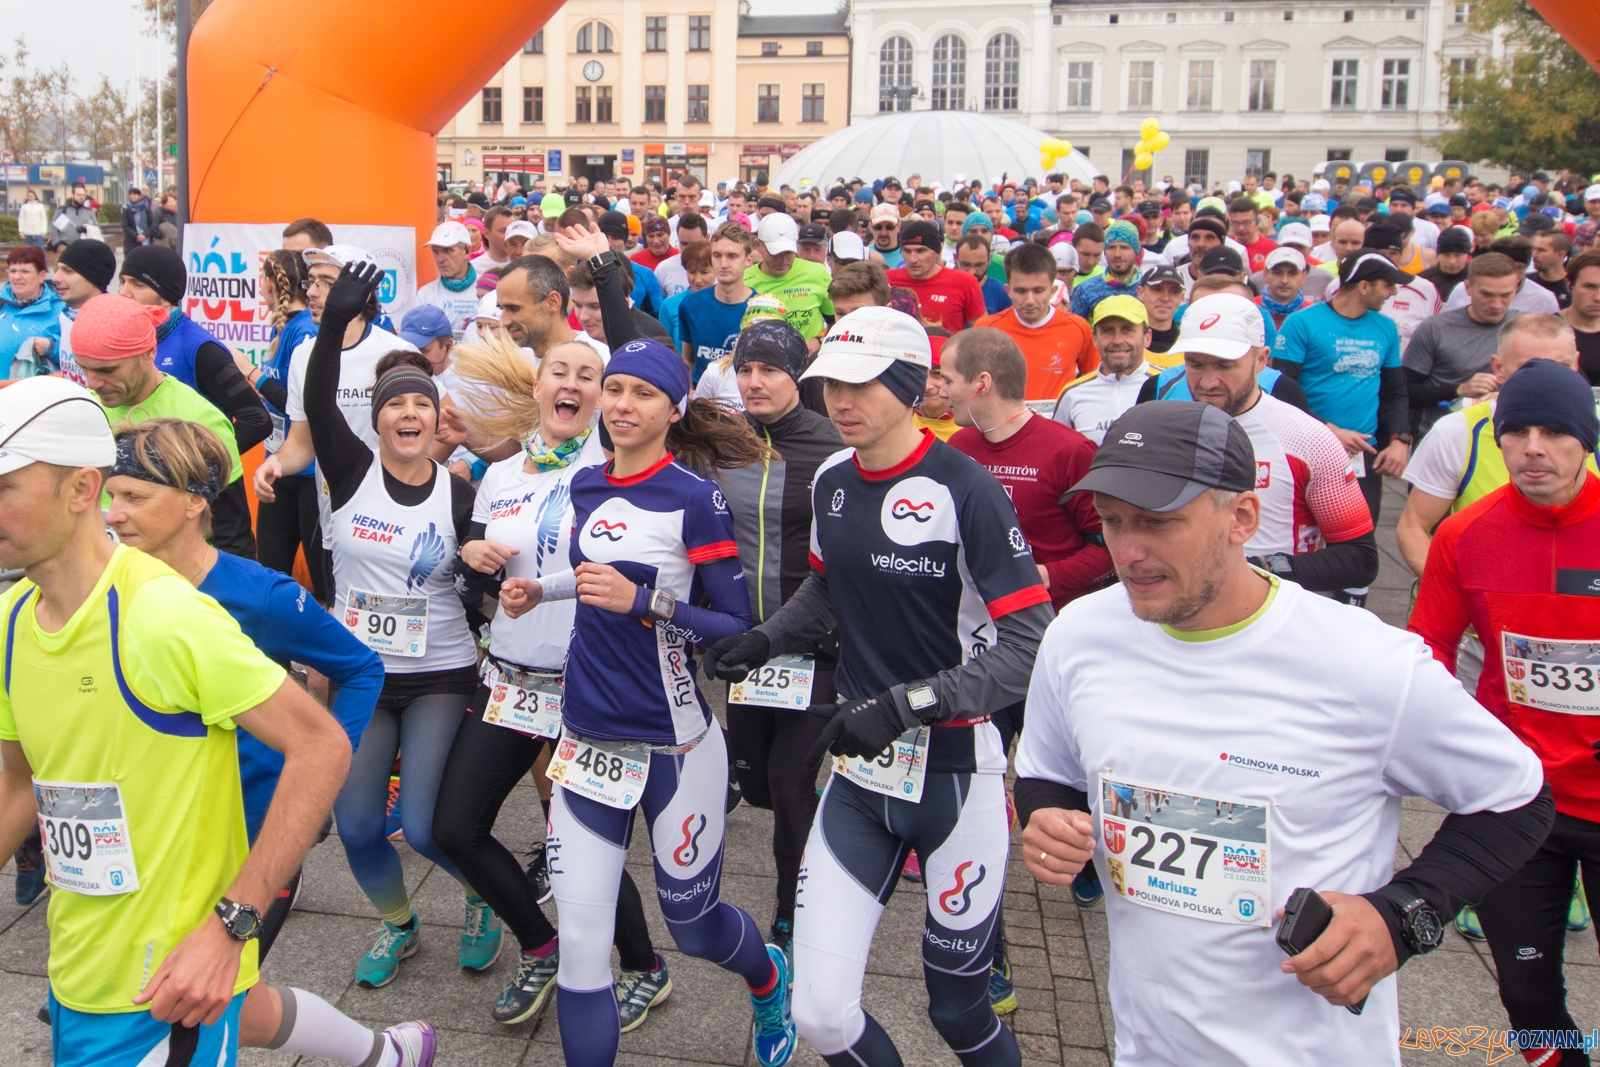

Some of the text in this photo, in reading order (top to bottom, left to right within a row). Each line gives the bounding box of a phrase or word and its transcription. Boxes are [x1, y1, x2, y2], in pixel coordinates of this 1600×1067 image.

[187, 277, 256, 299] MARATON
[824, 331, 864, 344] IRONMAN
[1118, 438, 1144, 448] Kalenji
[490, 506, 522, 521] TEAM
[351, 514, 406, 536] HERNIK
[352, 526, 393, 544] TEAM
[870, 552, 946, 578] velocity
[368, 614, 396, 636] 90
[655, 620, 703, 644] elocity
[368, 636, 392, 645] Ewelina
[666, 631, 692, 707] elocity
[748, 667, 791, 689] 425
[1530, 662, 1595, 692] 533
[512, 690, 538, 714] 23
[755, 689, 778, 697] Bartosz
[1536, 700, 1571, 710] POLINOVA
[504, 720, 526, 729] POLINOVA
[514, 713, 534, 722] Natalia
[574, 747, 624, 782] 468
[858, 764, 874, 776] Emil
[1229, 754, 1320, 778] POLINOVA POLSKA
[584, 778, 604, 790] Anna
[849, 770, 894, 792] POLINOVA POLSKA
[570, 782, 617, 804] POLINOVA POLSKA
[46, 820, 92, 861] 309
[1130, 826, 1218, 880] 227
[1224, 852, 1260, 864] MARATON
[58, 862, 84, 876] Tomasz
[1223, 866, 1266, 876] WĄGROWIEC
[1224, 873, 1267, 883] 23.10.2016
[56, 876, 78, 887] POLINOVA
[78, 880, 100, 890] POLSKA
[1148, 876, 1198, 896] Mariusz
[1136, 890, 1180, 908] POLINOVA
[1182, 902, 1222, 916] POLSKA
